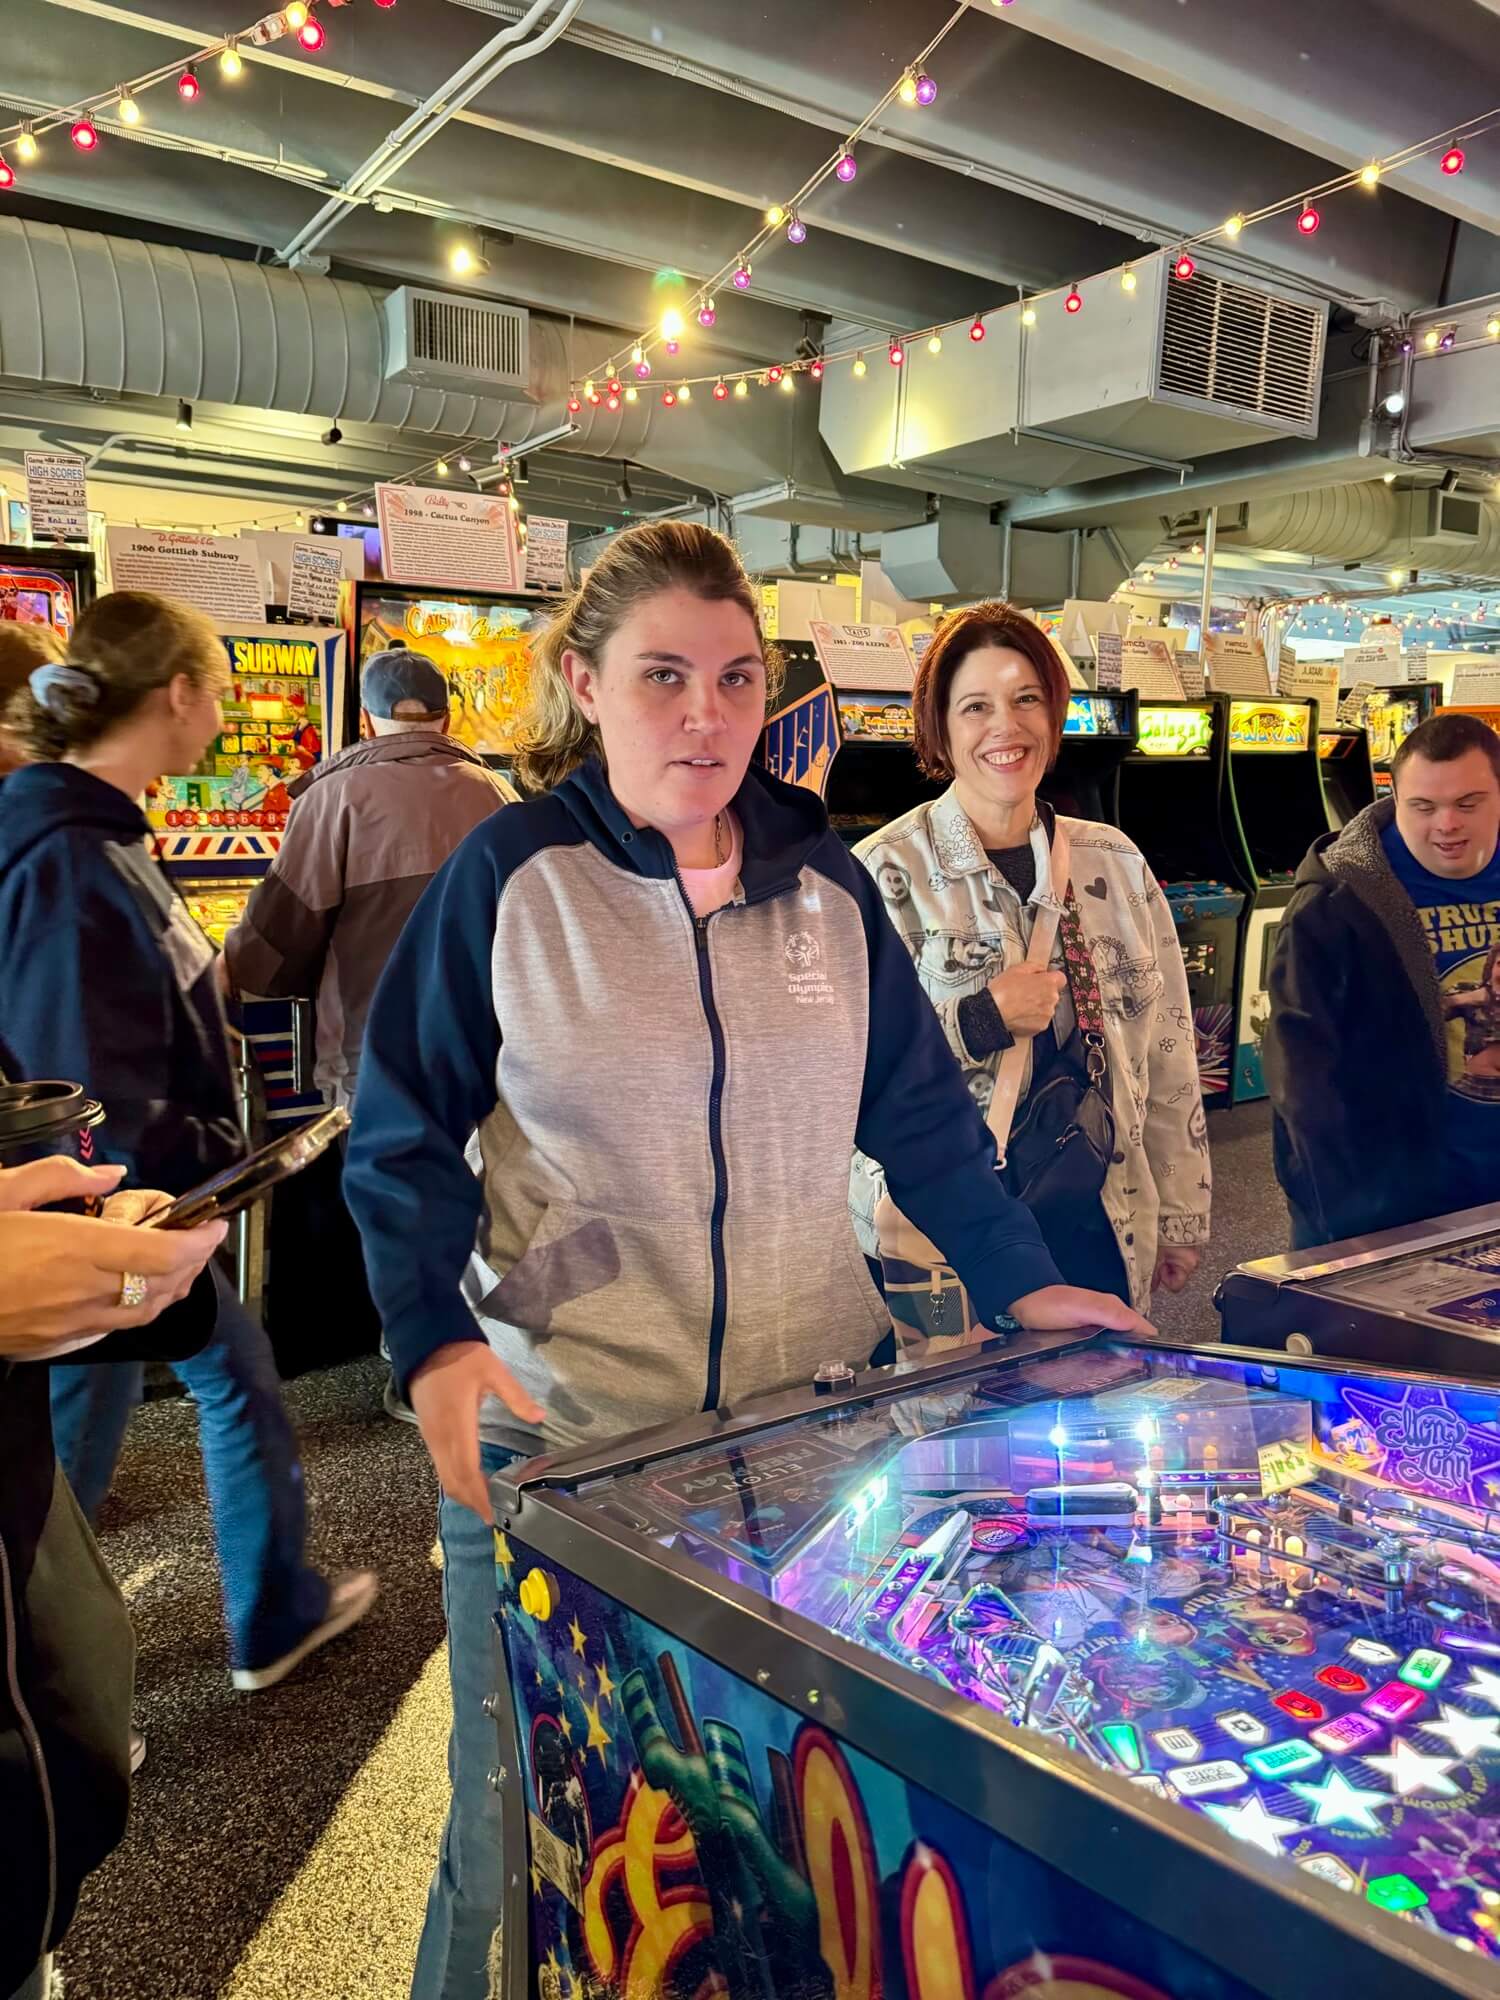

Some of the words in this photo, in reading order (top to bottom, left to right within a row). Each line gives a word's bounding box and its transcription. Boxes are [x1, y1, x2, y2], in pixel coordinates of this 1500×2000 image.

[29, 465, 49, 476] HIGH
[50, 467, 83, 480] SCORES
[425, 494, 450, 509] Bally
[430, 511, 458, 521] Cactus
[460, 514, 490, 525] Canyon
[158, 545, 198, 556] Gottlieb
[201, 549, 240, 562] Subway
[312, 556, 339, 568] SCORES
[234, 641, 318, 677] SUBWAY
[171, 813, 176, 824] 1
[185, 813, 193, 824] 2
[199, 813, 208, 824] 3
[212, 813, 220, 824] 4
[229, 813, 236, 824] 5
[241, 813, 249, 824] 6
[255, 813, 262, 824] 7
[268, 813, 276, 824] 8
[1375, 1405, 1468, 1450] Elton
[754, 1448, 817, 1472] FREE
[1398, 1444, 1473, 1491] John
[722, 1463, 803, 1490] ELTON
[1184, 1581, 1257, 1617] APTAIN
